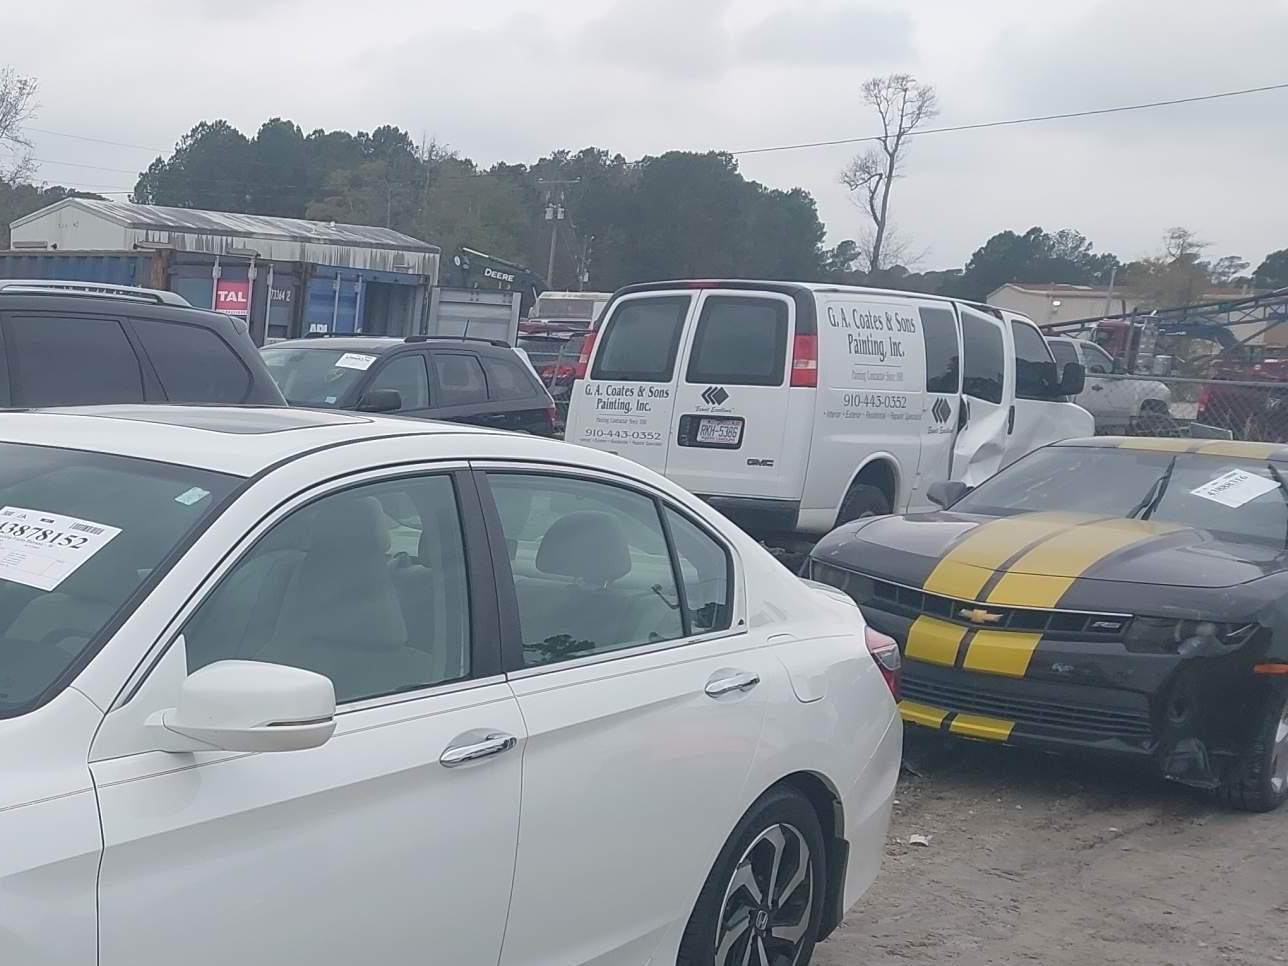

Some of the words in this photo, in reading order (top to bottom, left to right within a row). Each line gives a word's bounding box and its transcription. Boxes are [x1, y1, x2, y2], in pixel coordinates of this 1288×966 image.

[484, 267, 515, 282] DEERE
[217, 290, 247, 302] TAL
[828, 307, 839, 328] G.
[841, 307, 851, 329] A.
[852, 308, 883, 331] Coates
[885, 312, 893, 332] &
[895, 312, 916, 334] Sons
[848, 333, 887, 362] Painting,
[889, 336, 905, 357] Inc.
[585, 384, 592, 396] G.
[594, 384, 603, 396] A.
[606, 384, 634, 397] Coates
[637, 385, 645, 397] &
[648, 386, 670, 399] Sons
[596, 398, 633, 414] Painting,
[636, 399, 652, 412] Inc.
[585, 428, 661, 441] 910-443-0352
[746, 458, 775, 467] GMC
